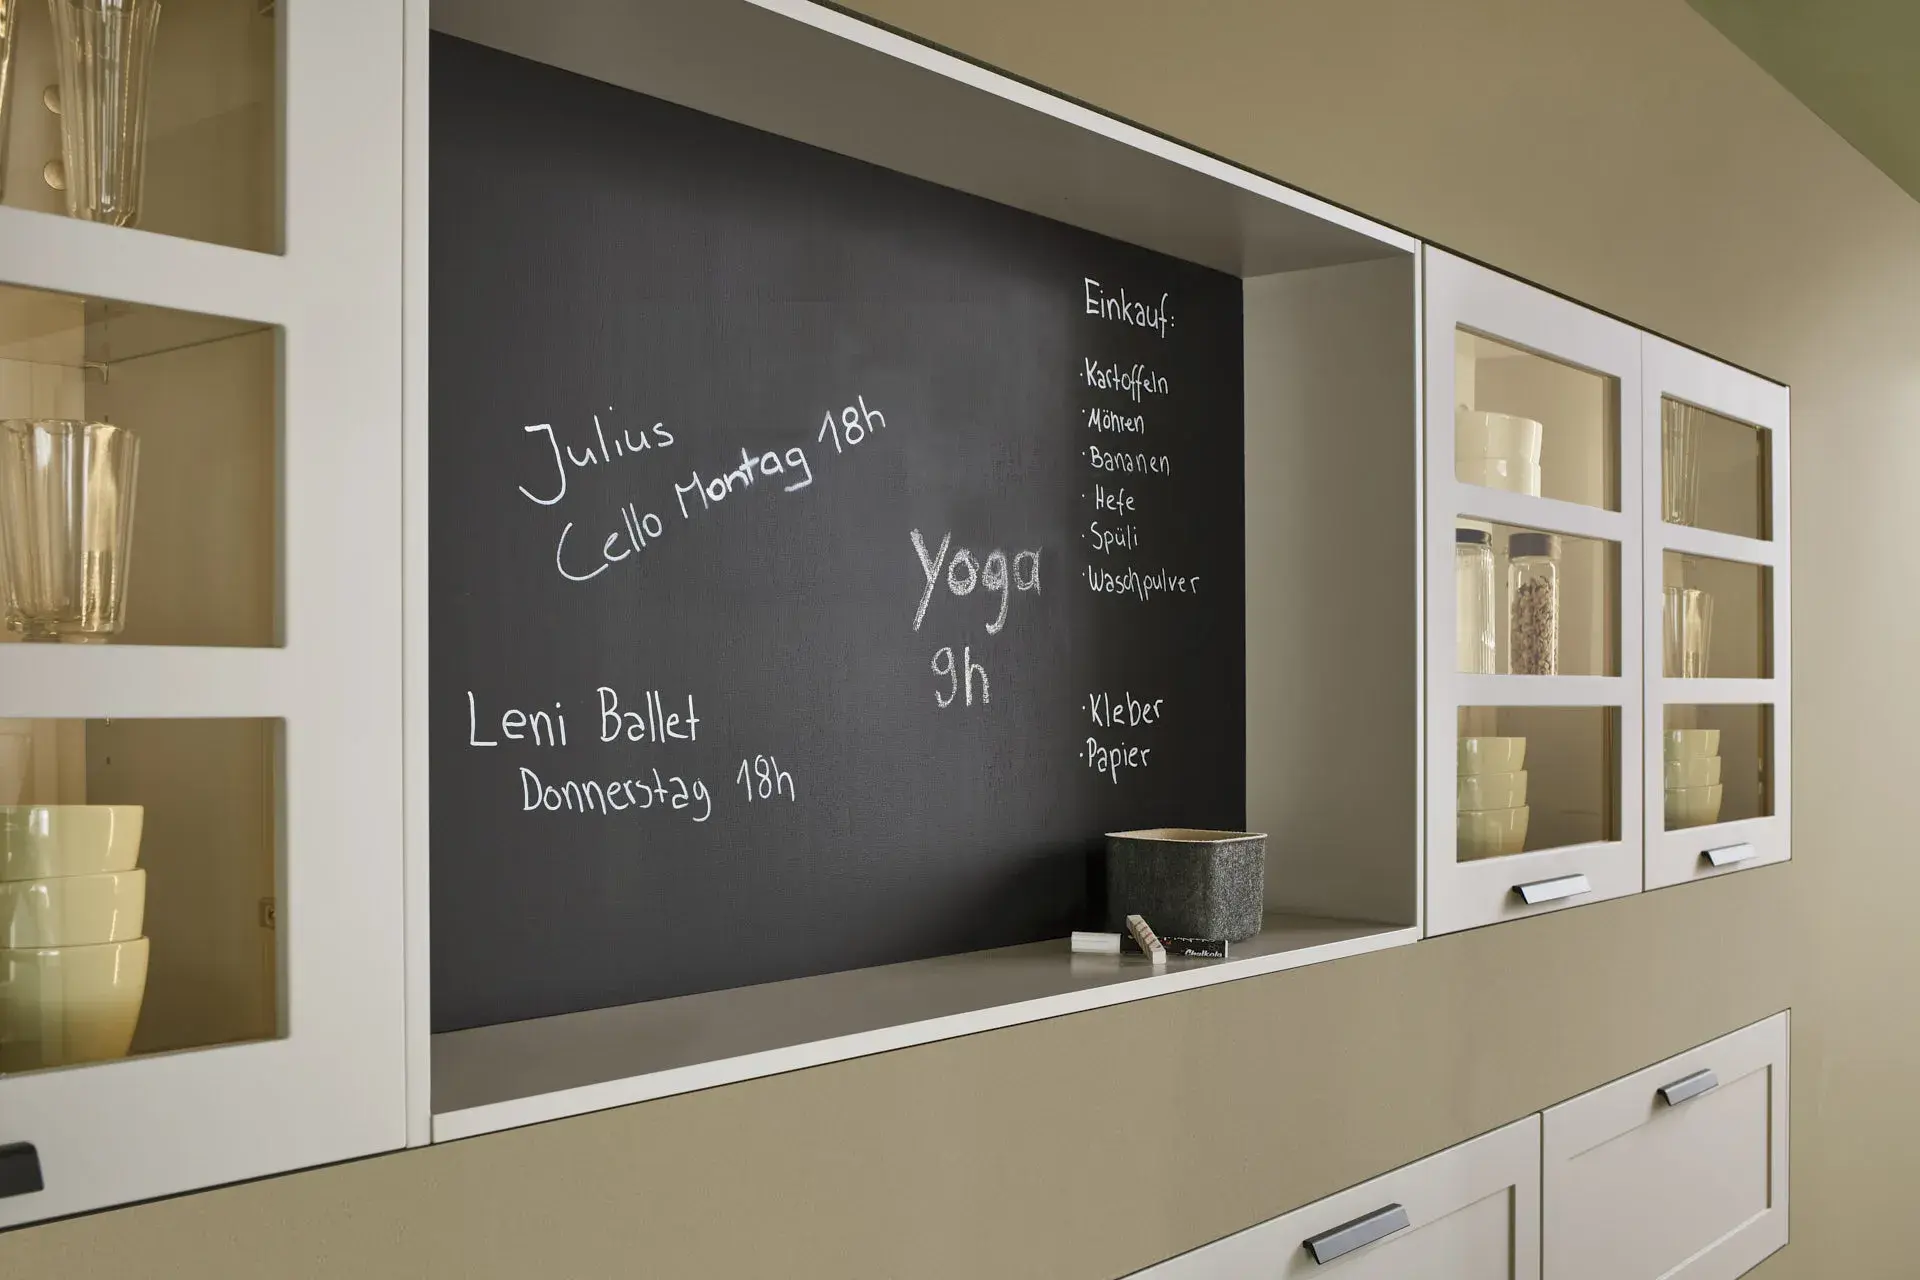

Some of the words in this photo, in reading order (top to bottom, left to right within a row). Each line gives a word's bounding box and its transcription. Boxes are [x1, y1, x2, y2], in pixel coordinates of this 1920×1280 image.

[1084, 277, 1176, 339] Einkauf:
[1085, 356, 1169, 403] Kartoffeln
[1087, 407, 1145, 435] Möhren
[518, 404, 675, 506] Julius
[1090, 445, 1170, 476] Bananen
[556, 502, 663, 582] Cello
[674, 446, 817, 519] Montag
[817, 394, 887, 456] 18h
[1095, 483, 1136, 517] Hefe
[1090, 521, 1138, 555] Spüli
[909, 527, 1043, 637] Yoga
[1087, 564, 1200, 602] Waschpulver
[928, 645, 993, 712] 9h
[467, 690, 567, 747] Leni
[596, 686, 701, 744] Ballet
[1089, 691, 1164, 728] Kleber
[1086, 736, 1151, 785] Papier
[518, 766, 713, 823] Donnerstag
[736, 754, 796, 803] 18h
